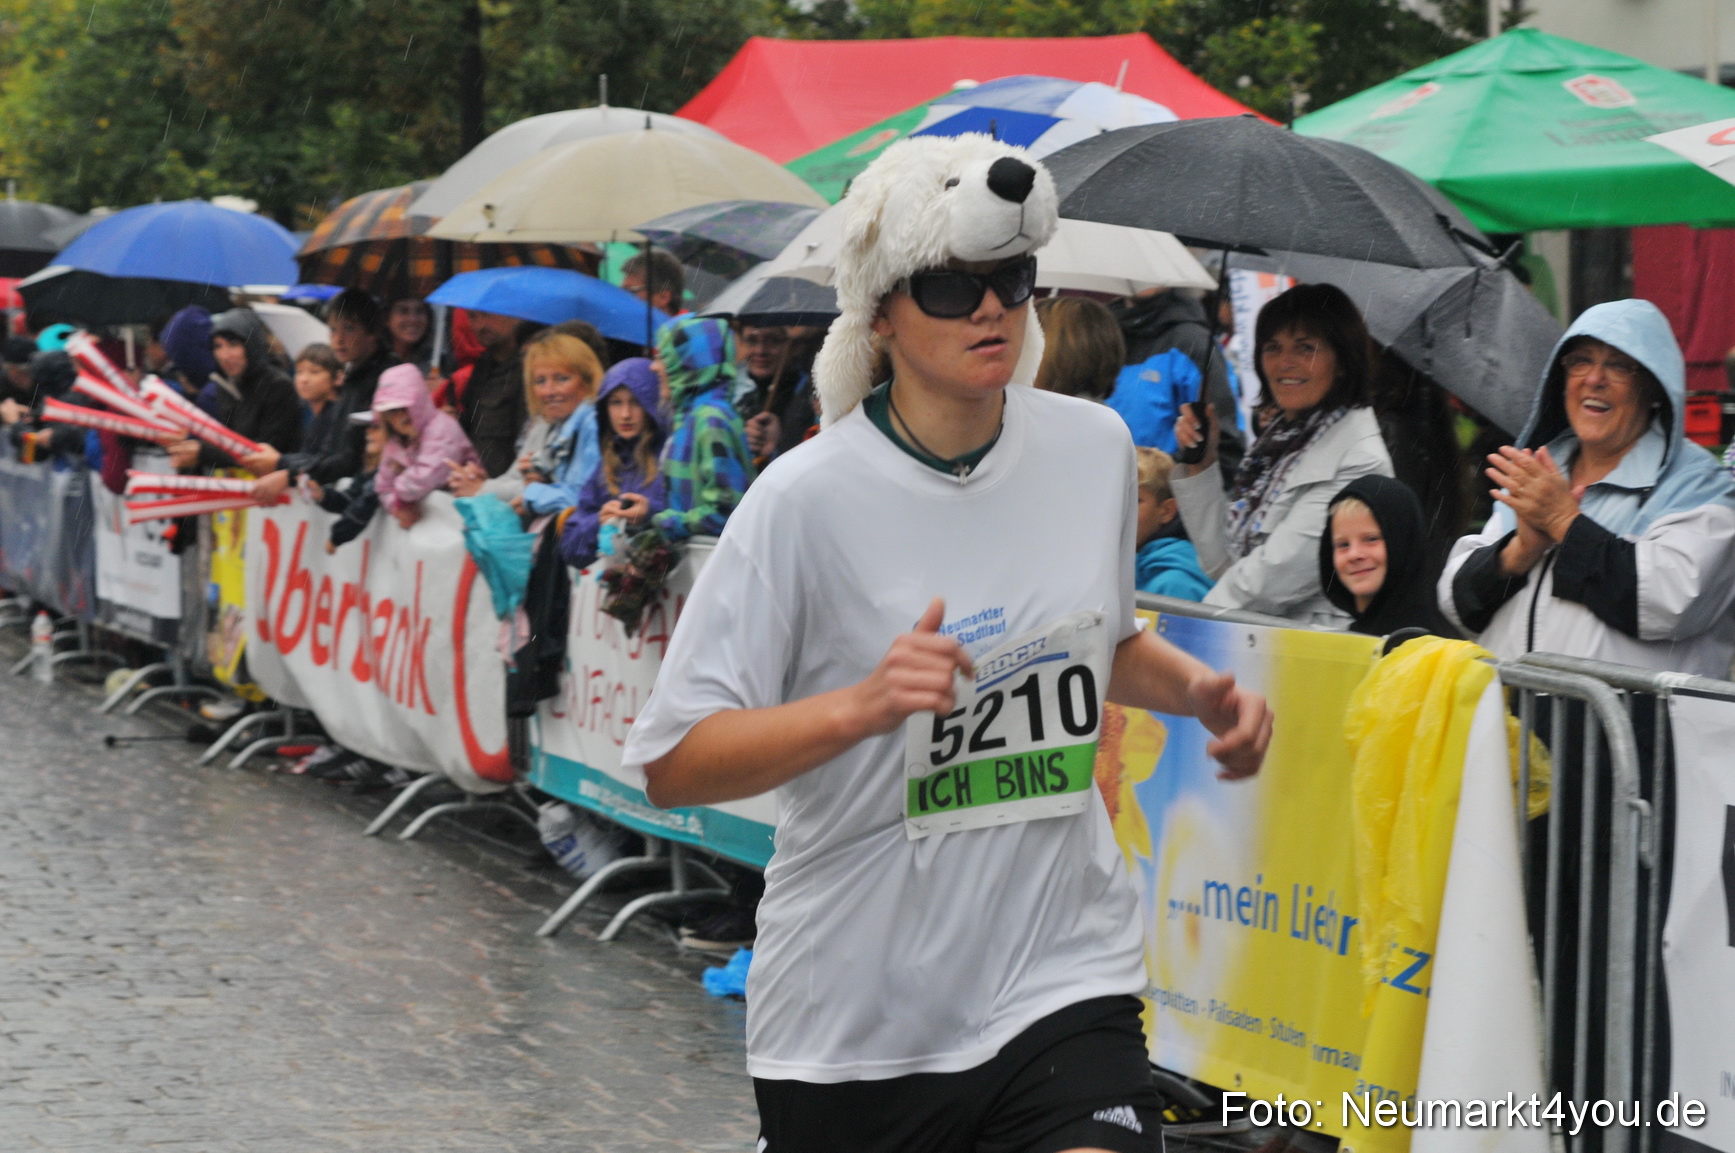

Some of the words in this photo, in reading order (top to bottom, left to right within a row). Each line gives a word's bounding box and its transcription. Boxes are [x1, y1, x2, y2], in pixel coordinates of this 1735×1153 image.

[957, 619, 1006, 646] Stadtlauf
[930, 664, 1098, 766] 5210
[918, 766, 972, 812] ICH
[996, 752, 1069, 799] BINS
